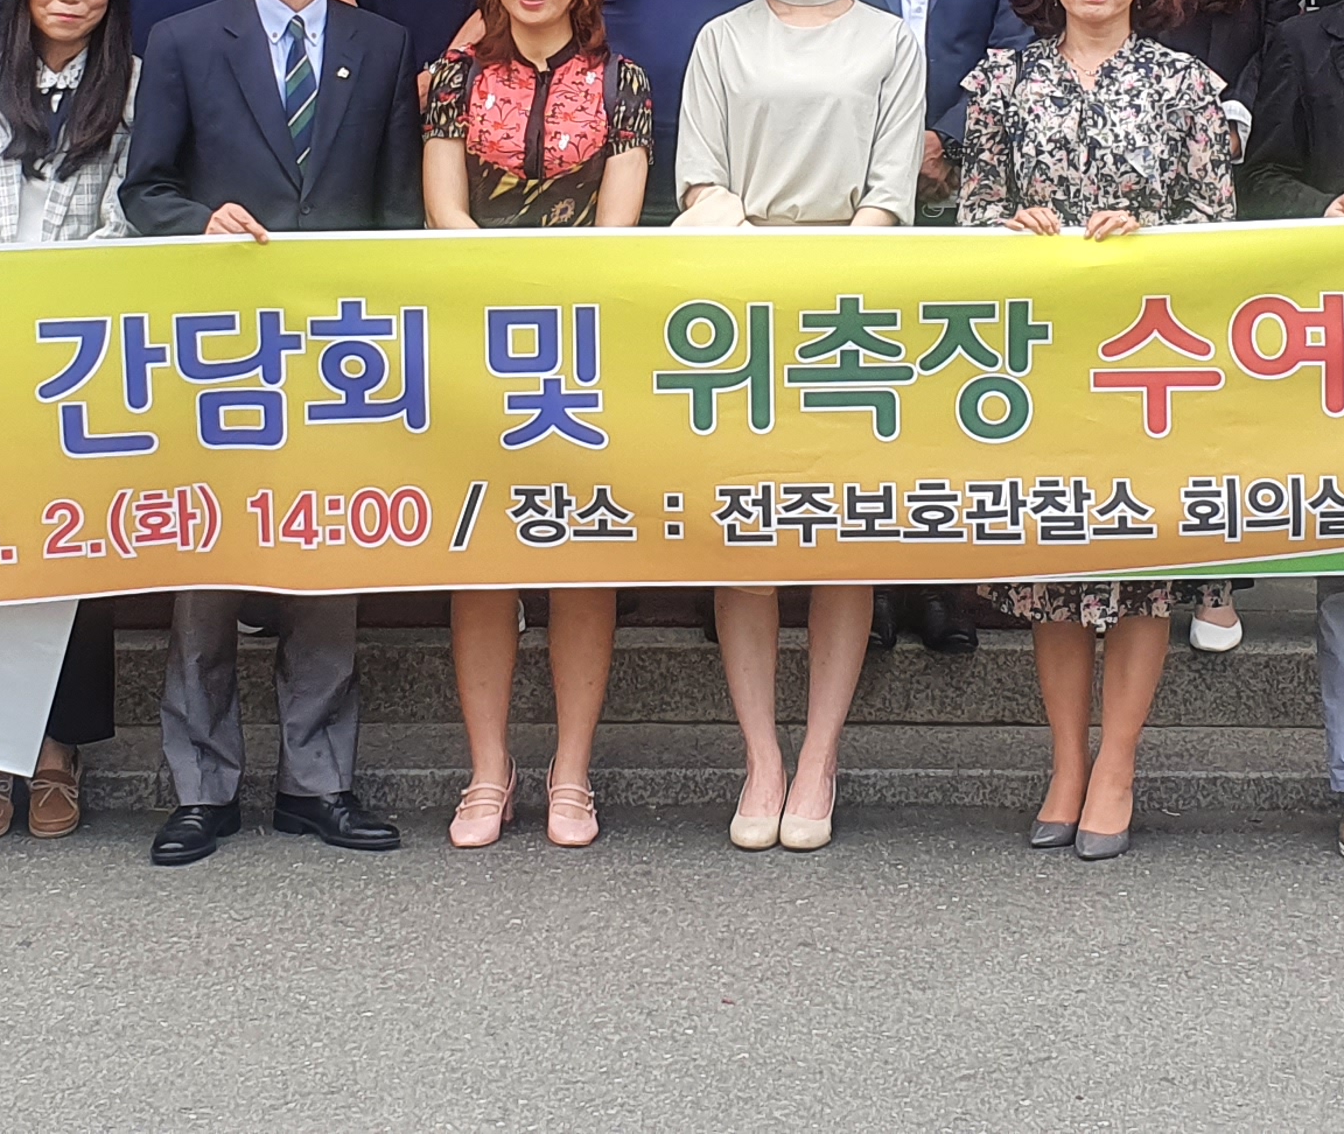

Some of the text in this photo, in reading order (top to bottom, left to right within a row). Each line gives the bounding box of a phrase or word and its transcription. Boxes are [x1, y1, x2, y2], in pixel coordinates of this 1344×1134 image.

[35, 297, 430, 458] 간담회
[484, 302, 609, 451] 및
[652, 294, 1052, 442] 위촉장
[42, 484, 222, 560] 2.(화)
[247, 485, 432, 552] 14:00
[449, 480, 487, 552] /
[508, 482, 638, 547] 장소
[662, 492, 684, 539] :
[714, 475, 1159, 548] 전주보호관찰소
